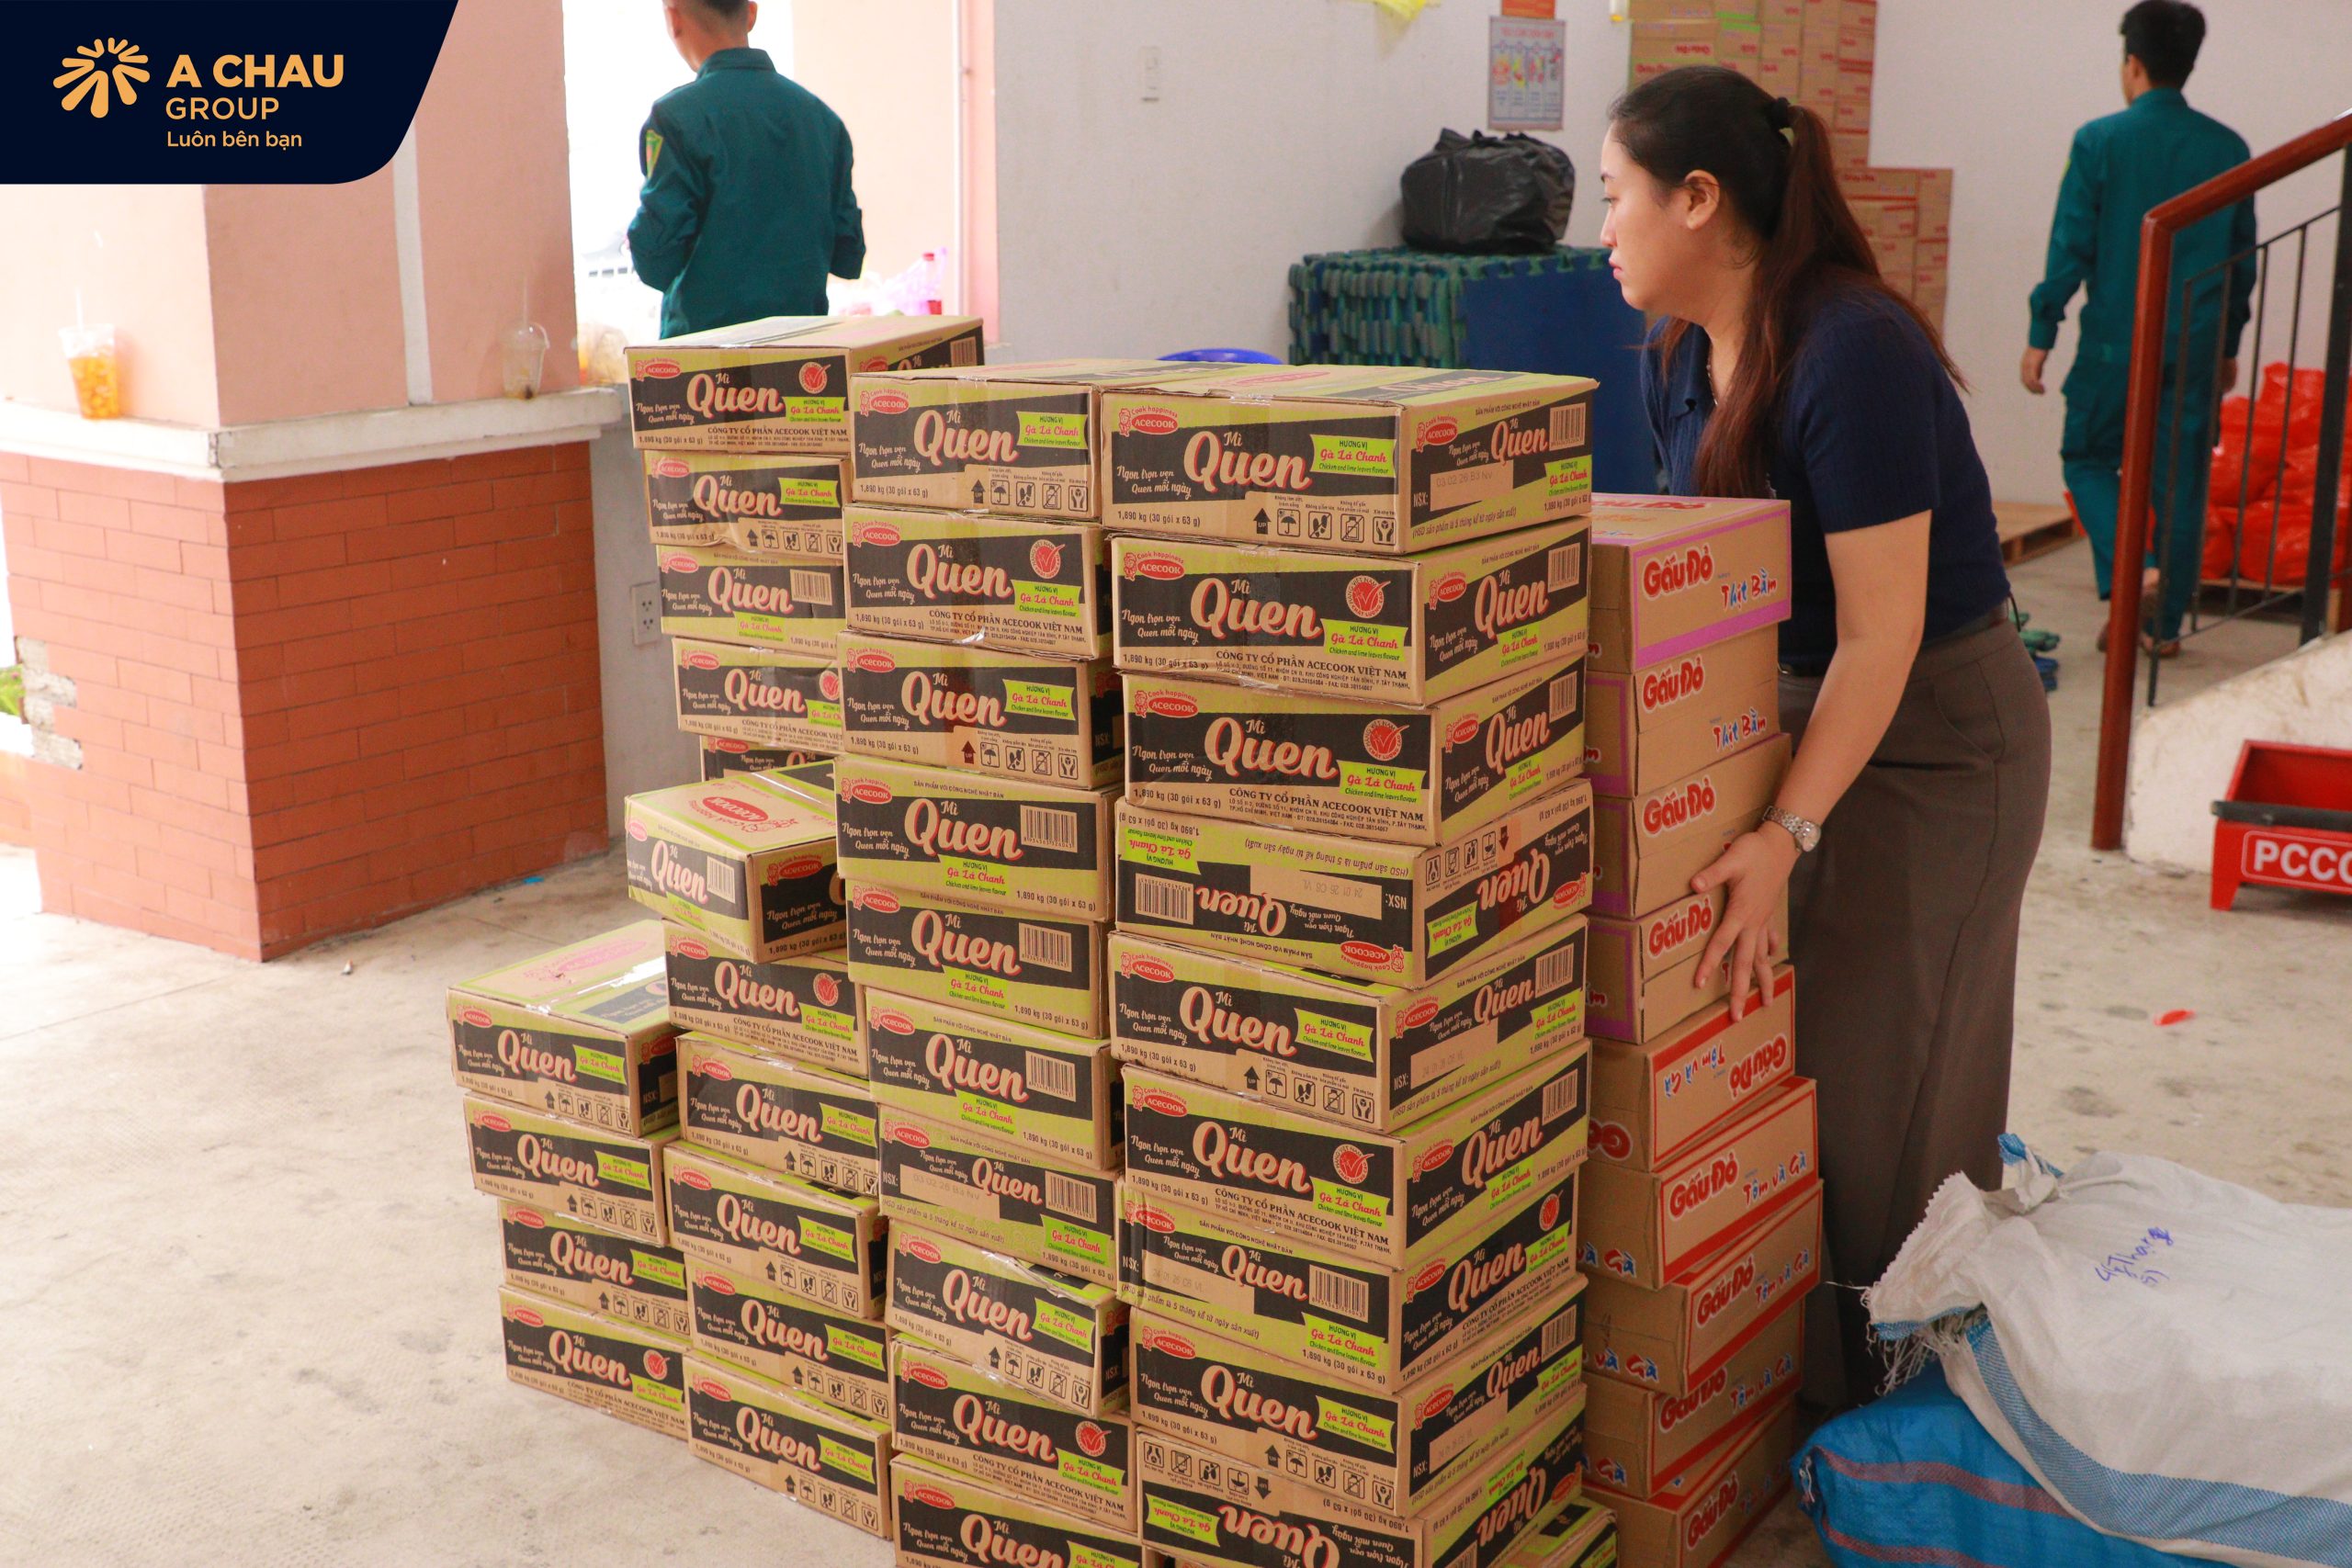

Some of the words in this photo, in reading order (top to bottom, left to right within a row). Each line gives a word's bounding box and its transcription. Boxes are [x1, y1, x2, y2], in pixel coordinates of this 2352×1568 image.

[686, 374, 785, 419] Quen
[1132, 406, 1148, 415] Cook
[914, 410, 1019, 468] Quen
[1134, 420, 1175, 428] ACECOOK
[1224, 432, 1242, 446] Mì
[1491, 421, 1549, 467] Quen
[1117, 465, 1139, 481] Ngon
[1142, 468, 1158, 481] trọn
[1159, 470, 1174, 479] vẹn
[1183, 431, 1312, 494] Quen
[1320, 449, 1334, 460] Gà
[1338, 450, 1352, 460] Lá
[1356, 450, 1387, 463] Chanh
[695, 475, 782, 519] Quen
[1132, 484, 1152, 494] Quen
[1155, 479, 1169, 492] mỗi
[1171, 482, 1192, 500] ngày
[1413, 492, 1428, 507] NSX:
[1139, 513, 1147, 522] kg
[1149, 513, 1159, 523] (30
[1163, 513, 1173, 525] gói
[1182, 516, 1190, 525] 63
[1193, 517, 1200, 527] g)
[707, 568, 795, 613] Quen
[906, 544, 1013, 601] Quen
[1644, 556, 1685, 597] Gấu
[1722, 583, 1747, 610] Thịt
[1751, 568, 1777, 597] Bằm
[1190, 578, 1323, 640] Quen
[1476, 573, 1551, 641] Quen
[725, 669, 807, 714] Quen
[901, 671, 1007, 728] Quen
[1643, 668, 1679, 711] Gấu
[1204, 717, 1339, 780] Quen
[1486, 708, 1551, 775] Quen
[1713, 721, 1738, 751] Thịt
[1742, 707, 1766, 737] Bằm
[1229, 787, 1257, 799] CÔNG
[1260, 792, 1272, 801] TY
[1275, 791, 1289, 803] CỔ
[1291, 794, 1319, 807] PHẦN
[1321, 801, 1371, 814] ACECOOK
[1374, 807, 1398, 819] VIỆT
[1400, 812, 1424, 822] NAM
[1644, 791, 1686, 834] Gấu
[902, 798, 1025, 860] Quen
[1278, 845, 1295, 855] ngày
[651, 840, 708, 904] Quen
[1316, 852, 1336, 863] tháng
[1390, 867, 1409, 877] (HSD
[1476, 848, 1549, 912] Quen
[1193, 886, 1285, 935] Quen
[1385, 893, 1408, 909] NSX:
[910, 909, 1022, 976] Quen
[1648, 913, 1688, 956] Gấu
[715, 961, 800, 1018] Quen
[1476, 977, 1534, 1025] Quen
[1180, 987, 1296, 1057] Quen
[498, 1030, 577, 1082] Quen
[924, 1033, 1029, 1102] Quen
[1685, 1060, 1698, 1084] và
[1702, 1043, 1725, 1069] Tôm
[1753, 1036, 1786, 1077] Gấu
[1665, 1072, 1681, 1098] Gà
[736, 1084, 822, 1143] Quen
[518, 1134, 599, 1187] Quen
[1193, 1122, 1312, 1193] Quen
[1462, 1111, 1544, 1190] Quen
[972, 1158, 1043, 1205] Quen
[1670, 1171, 1711, 1218] Gấu
[1743, 1179, 1769, 1205] Tôm
[1772, 1163, 1786, 1187] và
[1790, 1150, 1806, 1176] Gà
[717, 1194, 801, 1255] Quen
[550, 1232, 634, 1285] Quen
[1122, 1256, 1139, 1273] NSX:
[1221, 1246, 1308, 1301] Quen
[1449, 1240, 1527, 1312] Quen
[1604, 1249, 1635, 1278] Gà
[943, 1269, 1033, 1341] Quen
[741, 1301, 828, 1361] Quen
[549, 1332, 632, 1386] Quen
[1487, 1347, 1540, 1398] Quen
[1595, 1348, 1619, 1371] và
[1626, 1354, 1657, 1382] Gà
[1201, 1366, 1317, 1439] Quen
[736, 1407, 820, 1471] Quen
[953, 1394, 1057, 1462] Quen
[1595, 1458, 1626, 1485] Gà
